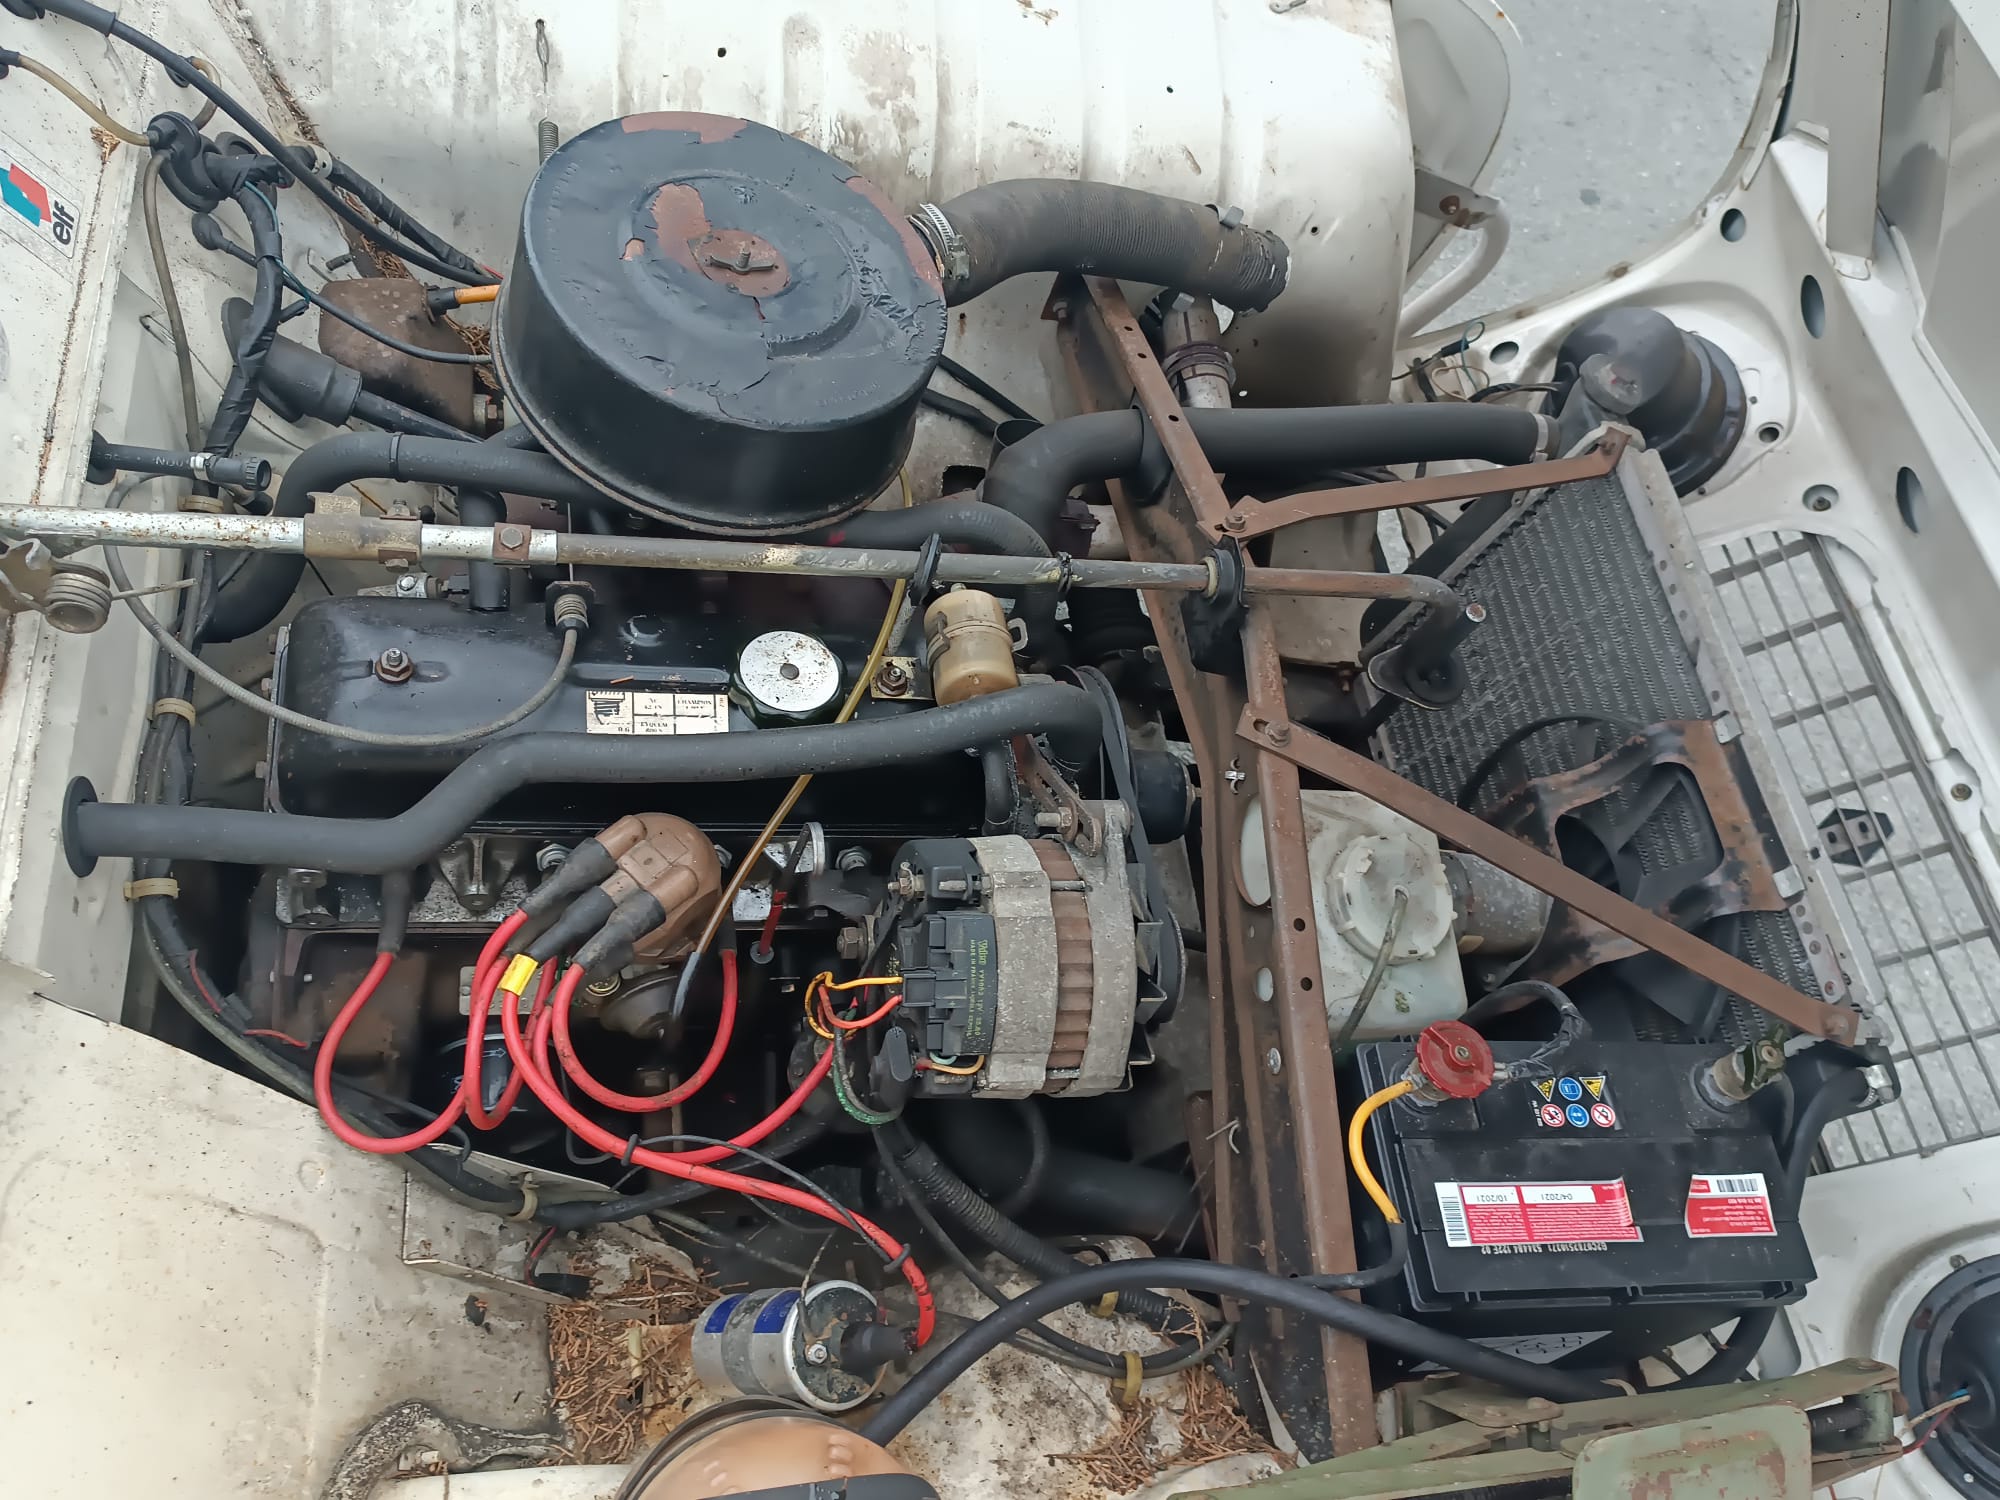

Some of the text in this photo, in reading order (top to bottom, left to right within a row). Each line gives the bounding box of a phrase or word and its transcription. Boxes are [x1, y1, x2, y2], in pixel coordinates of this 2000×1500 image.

[52, 199, 75, 246] elf
[1476, 1193, 1509, 1203] 10/2021
[1540, 1192, 1573, 1201] 04/2021
